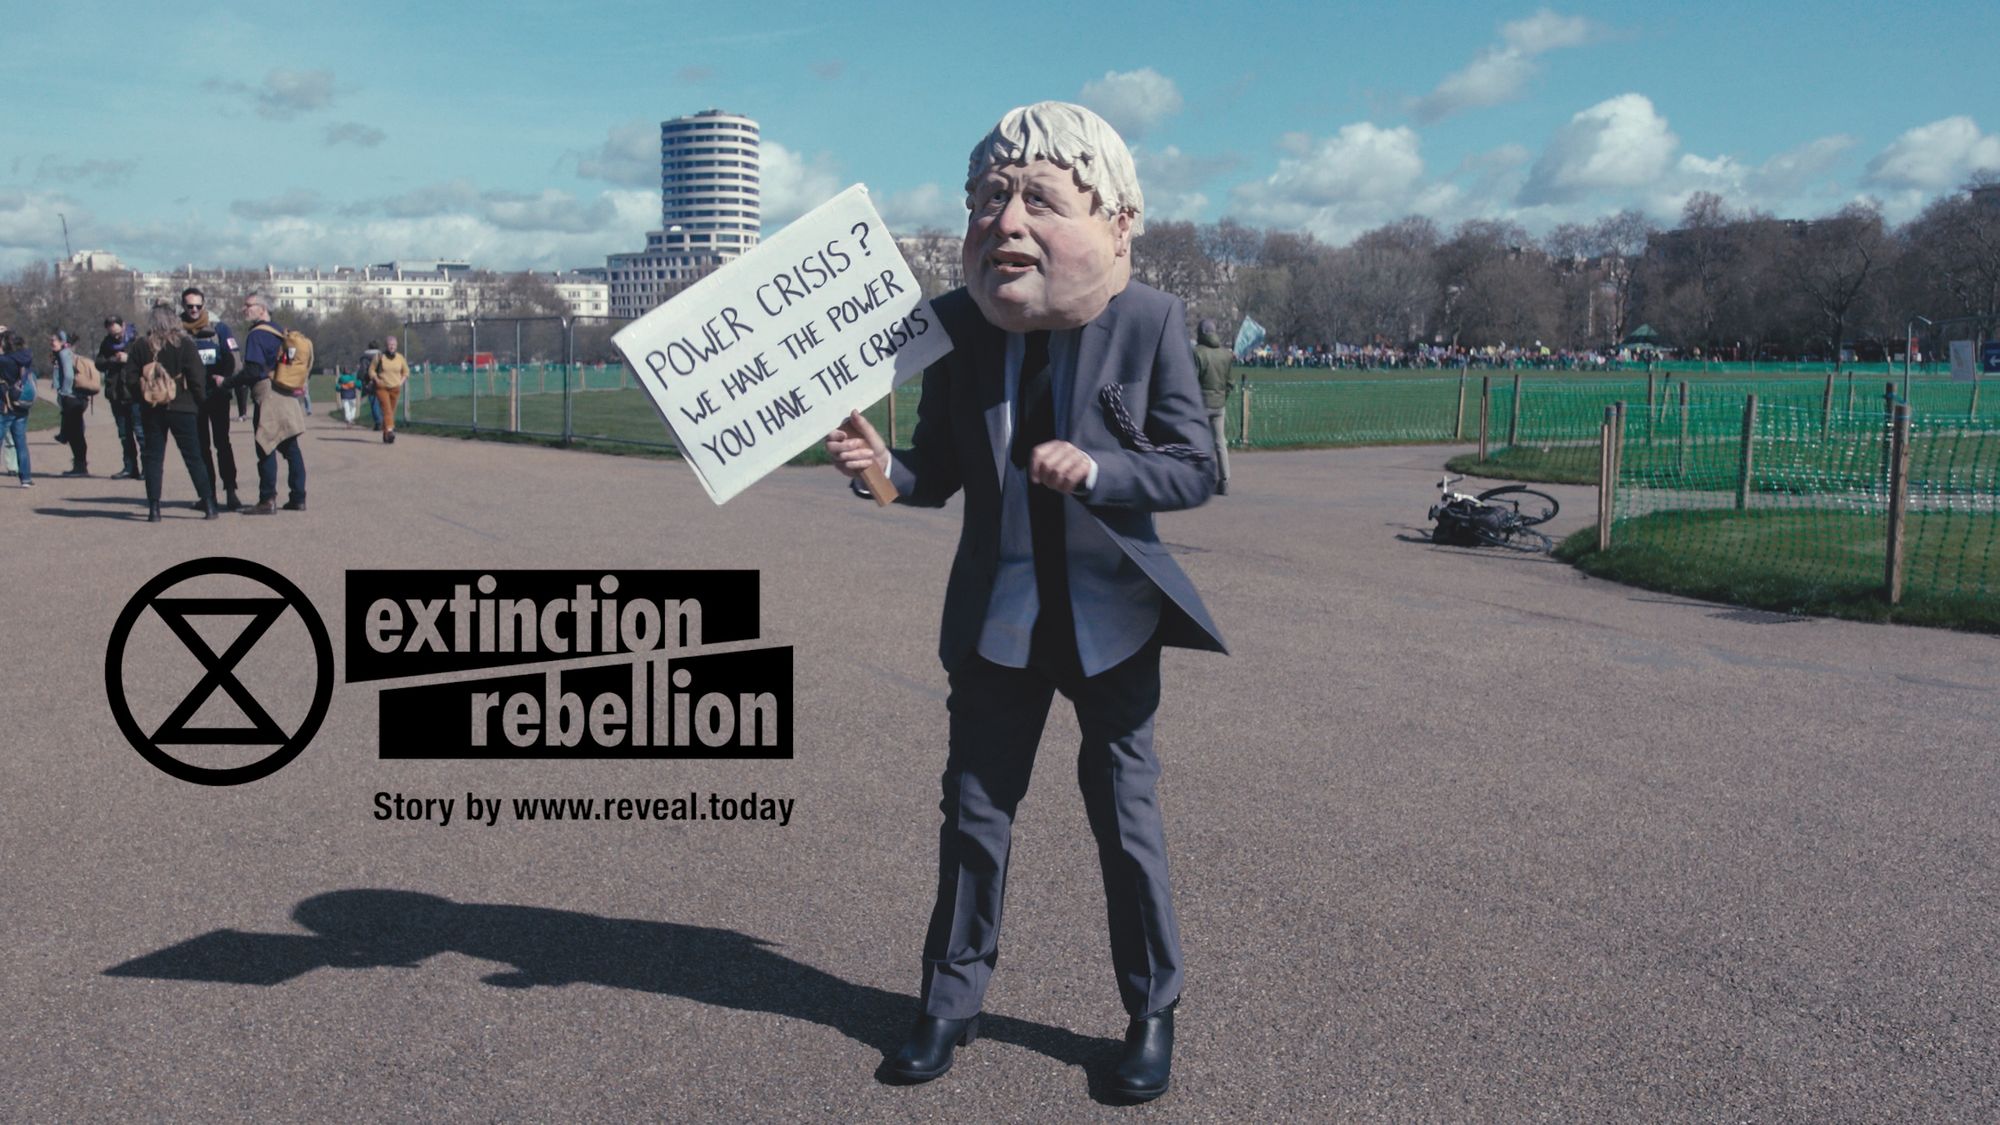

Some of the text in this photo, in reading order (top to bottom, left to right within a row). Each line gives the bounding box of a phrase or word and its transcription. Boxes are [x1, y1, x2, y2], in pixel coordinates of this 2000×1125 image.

[645, 307, 753, 390] POWER
[681, 269, 904, 425] WE HAVE THE POWER
[701, 308, 929, 465] YOU HAVE THE CRISIS
